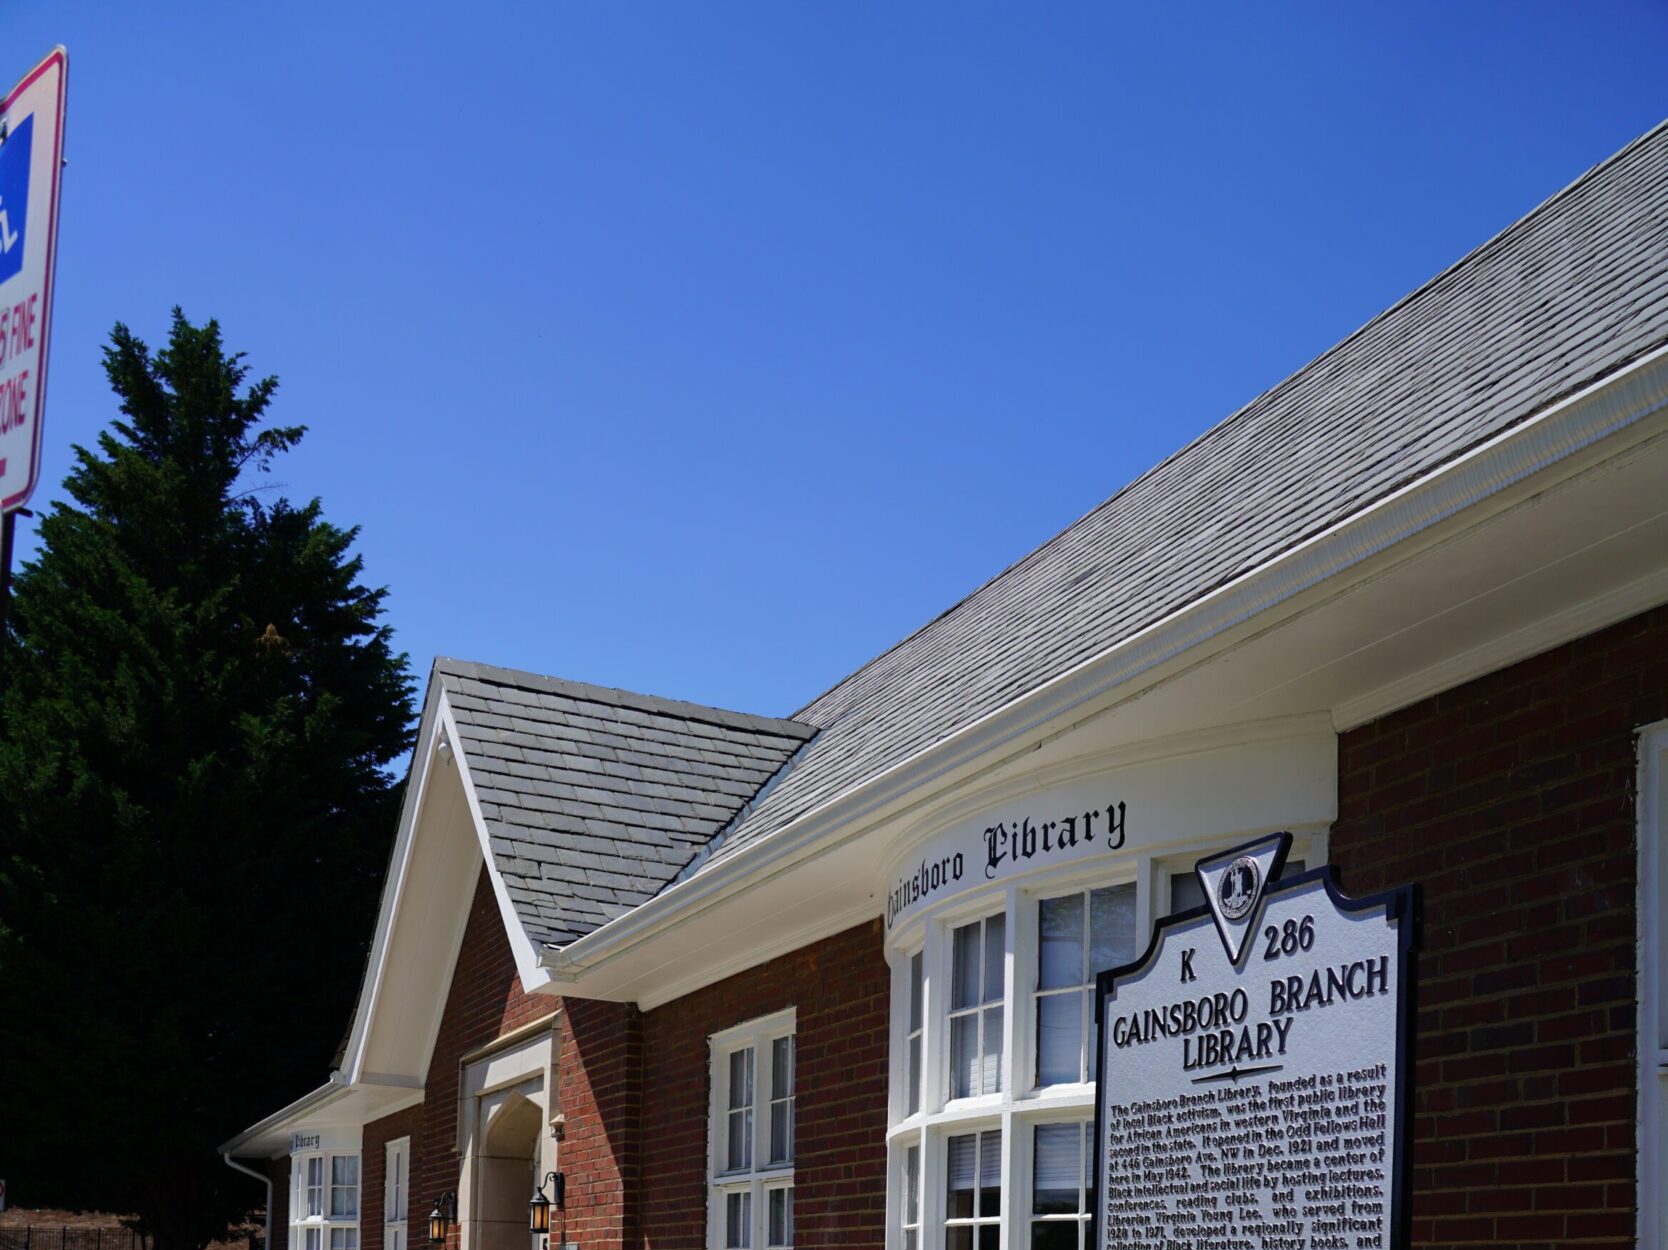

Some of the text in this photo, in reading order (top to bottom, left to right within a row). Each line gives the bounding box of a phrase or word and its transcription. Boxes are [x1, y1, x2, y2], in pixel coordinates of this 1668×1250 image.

[10, 292, 37, 360] FINE
[984, 800, 1126, 879] Library
[1180, 914, 1315, 983] K 286
[1113, 955, 1390, 1047] GAINSBORO BRANCH
[1183, 1016, 1294, 1070] LIBRARY
[1110, 1119, 1120, 1131] of
[1123, 1116, 1145, 1130] local
[1147, 1112, 1174, 1126] Black
[1226, 1104, 1247, 1116] was
[1248, 1100, 1267, 1112] the
[1269, 1094, 1295, 1109] first
[1298, 1089, 1335, 1106] public
[1339, 1084, 1386, 1099] library
[1111, 1104, 1129, 1118] The
[1131, 1099, 1178, 1114] Gainsboro
[1180, 1090, 1216, 1107] Branch
[1269, 1074, 1316, 1093] founded
[1320, 1074, 1333, 1086] as
[1336, 1072, 1343, 1083] a
[1347, 1064, 1386, 1083] result
[1110, 1098, 1386, 1145] for African Americans in western Virginia and the
[1110, 1145, 1139, 1159] second
[1141, 1143, 1151, 1154] in
[1152, 1141, 1169, 1152] the
[1203, 1135, 1211, 1147] It
[1212, 1130, 1250, 1147] opened
[1252, 1130, 1262, 1142] in
[1265, 1127, 1284, 1140] the
[1286, 1123, 1311, 1138] Odd
[1314, 1119, 1358, 1136] Fellows
[1360, 1114, 1386, 1130] Hall
[1109, 1161, 1119, 1172] at
[1122, 1158, 1140, 1170] 446
[1143, 1154, 1192, 1169] Gainsboro
[1221, 1147, 1240, 1161] NW
[1243, 1146, 1254, 1158] in
[1288, 1139, 1312, 1154] 1921
[1316, 1136, 1339, 1151] and
[1344, 1131, 1385, 1148] moved
[1109, 1174, 1129, 1185] here
[1132, 1172, 1141, 1183] in
[1143, 1170, 1164, 1183] May
[1200, 1165, 1220, 1177] The
[1223, 1162, 1264, 1175] library
[1267, 1159, 1310, 1172] became
[1314, 1157, 1320, 1168] a
[1324, 1151, 1366, 1166] center
[1370, 1148, 1385, 1162] of
[1108, 1187, 1132, 1199] Black
[1134, 1182, 1188, 1197] intellectual
[1190, 1180, 1208, 1192] and
[1210, 1178, 1239, 1191] social
[1241, 1176, 1260, 1189] life
[1264, 1175, 1279, 1189] by
[1282, 1172, 1327, 1186] hosting
[1176, 1195, 1218, 1210] reading
[1272, 1188, 1294, 1202] and
[1108, 1214, 1151, 1226] Librarian
[1155, 1211, 1196, 1223] Virginia
[1201, 1209, 1233, 1222] Young
[1273, 1204, 1297, 1218] who
[1302, 1202, 1345, 1217] served
[1351, 1200, 1383, 1214] from
[1132, 1227, 1141, 1238] to
[1173, 1224, 1226, 1239] developed
[1230, 1226, 1237, 1236] a
[1242, 1221, 1304, 1237] regionally
[1311, 1216, 1383, 1235] significant
[1356, 1233, 1382, 1248] and
